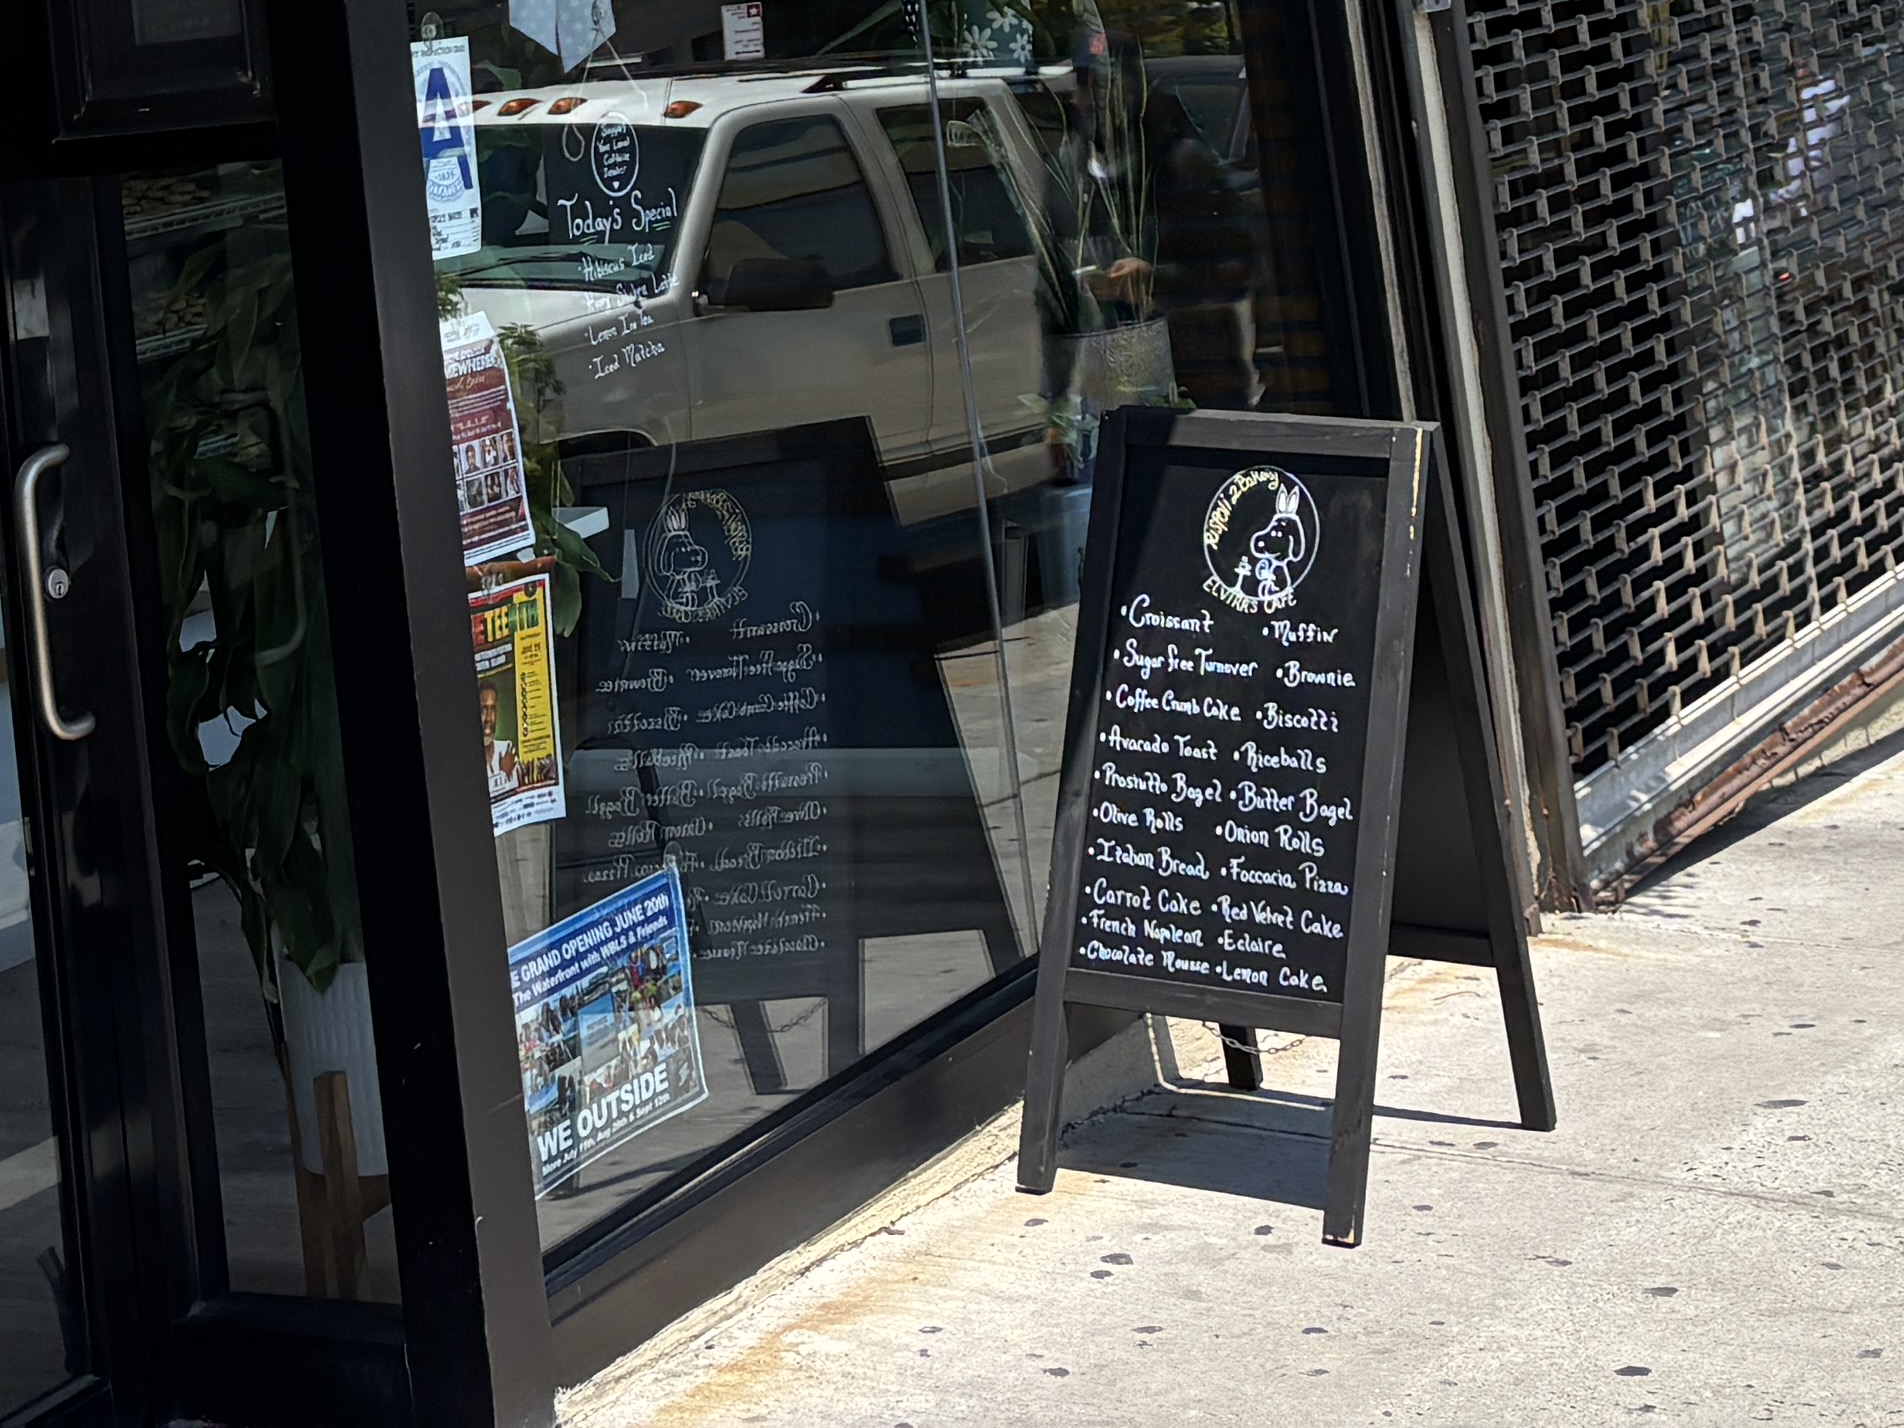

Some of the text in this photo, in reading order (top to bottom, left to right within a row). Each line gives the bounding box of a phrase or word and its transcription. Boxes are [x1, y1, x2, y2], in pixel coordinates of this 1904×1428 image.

[557, 187, 677, 245] Today's Special
[582, 243, 655, 282] Hibiscus Iced
[1128, 594, 1214, 634] Croissant
[1271, 621, 1338, 646] Muffin
[1123, 638, 1165, 680] Sugar
[1194, 648, 1259, 677] Turnover
[1283, 661, 1356, 688] Brownie
[1116, 683, 1242, 722] Coffee Crumb Cake
[1263, 702, 1339, 733] Biscotti
[1174, 735, 1218, 761] Toast
[1240, 741, 1327, 774] Riceballs
[1171, 773, 1222, 808] Bagel
[1237, 781, 1353, 827] Butter Bagel
[1099, 801, 1184, 834] Olive Rolls
[1224, 820, 1326, 858] Onion Rolls
[1096, 838, 1210, 880] Italian Bread
[1093, 877, 1202, 916] Carrot Cake
[1298, 862, 1349, 896] Pizza
[1089, 909, 1137, 939] French
[1217, 894, 1248, 924] Red
[1300, 910, 1344, 939] Cake
[521, 894, 669, 982] GRAND OPENING JUNE 20th
[532, 963, 580, 999] Waterfront
[581, 951, 601, 973] with
[628, 931, 636, 946] &
[1087, 940, 1211, 975] Chocolate Mousse
[1221, 960, 1328, 993] Lemon Cake
[537, 1063, 669, 1162] WE OUTSIDE
